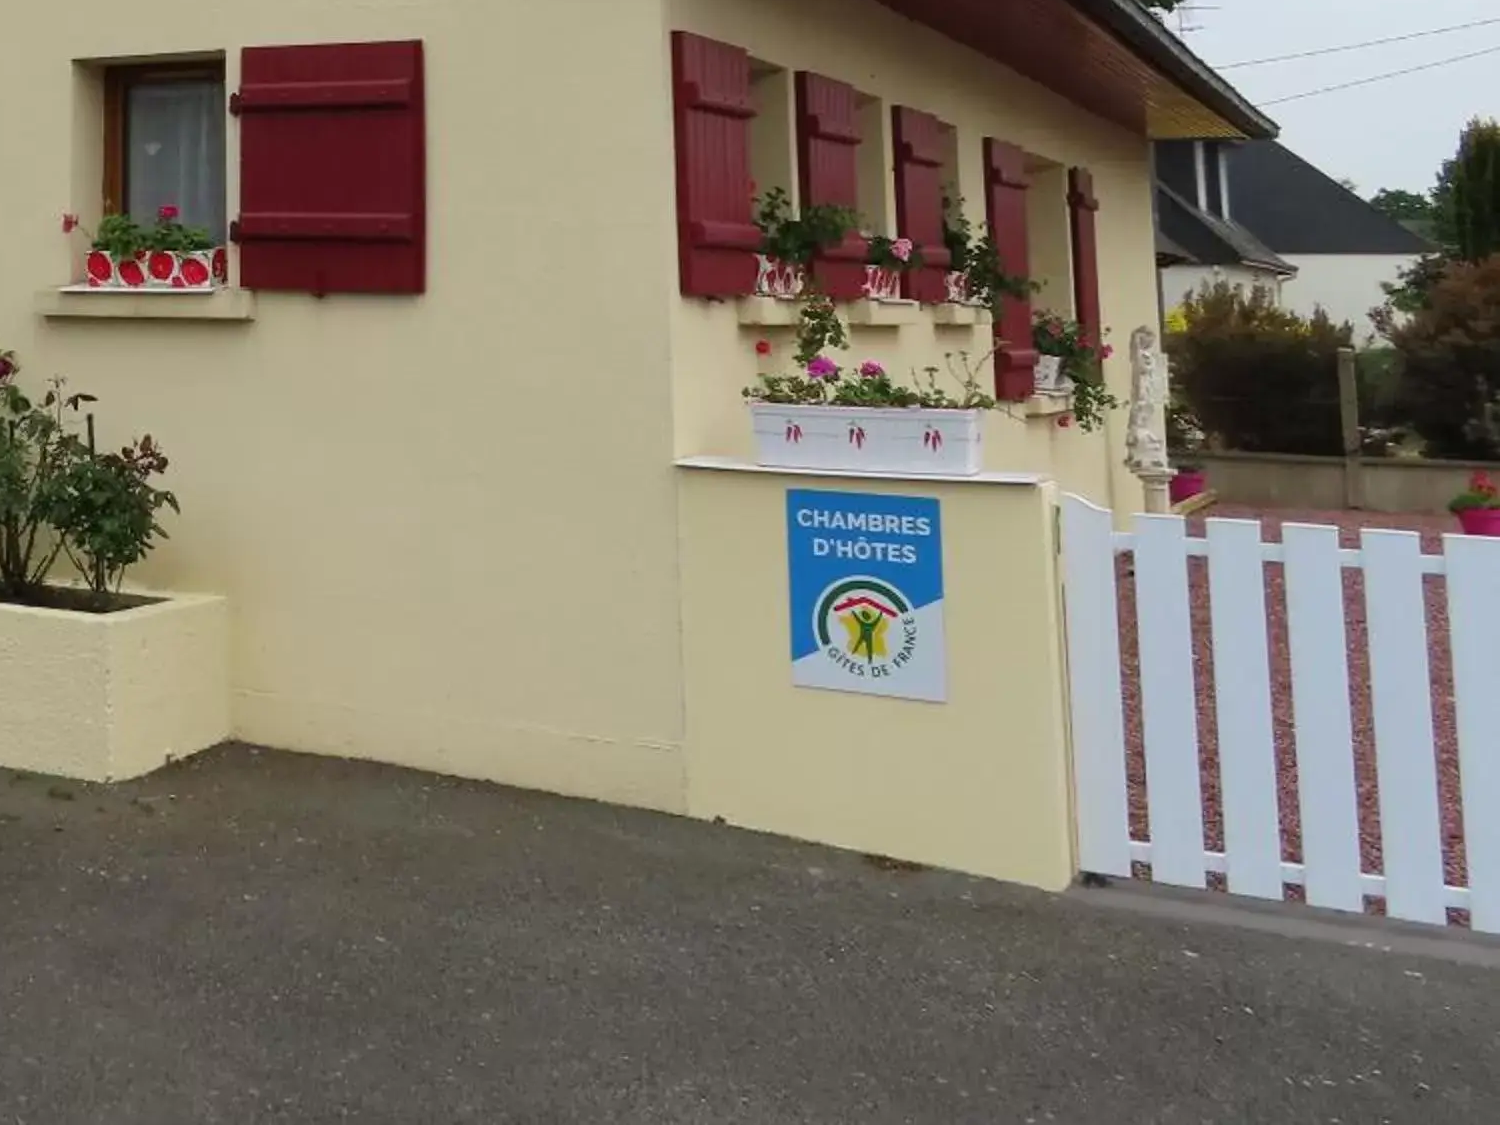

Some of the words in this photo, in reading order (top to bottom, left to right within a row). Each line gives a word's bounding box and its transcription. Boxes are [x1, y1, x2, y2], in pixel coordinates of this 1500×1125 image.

[796, 509, 931, 536] CHAMBRES
[813, 536, 917, 564] D'HÔTES
[871, 665, 890, 678] DE
[892, 617, 916, 669] FRANCE
